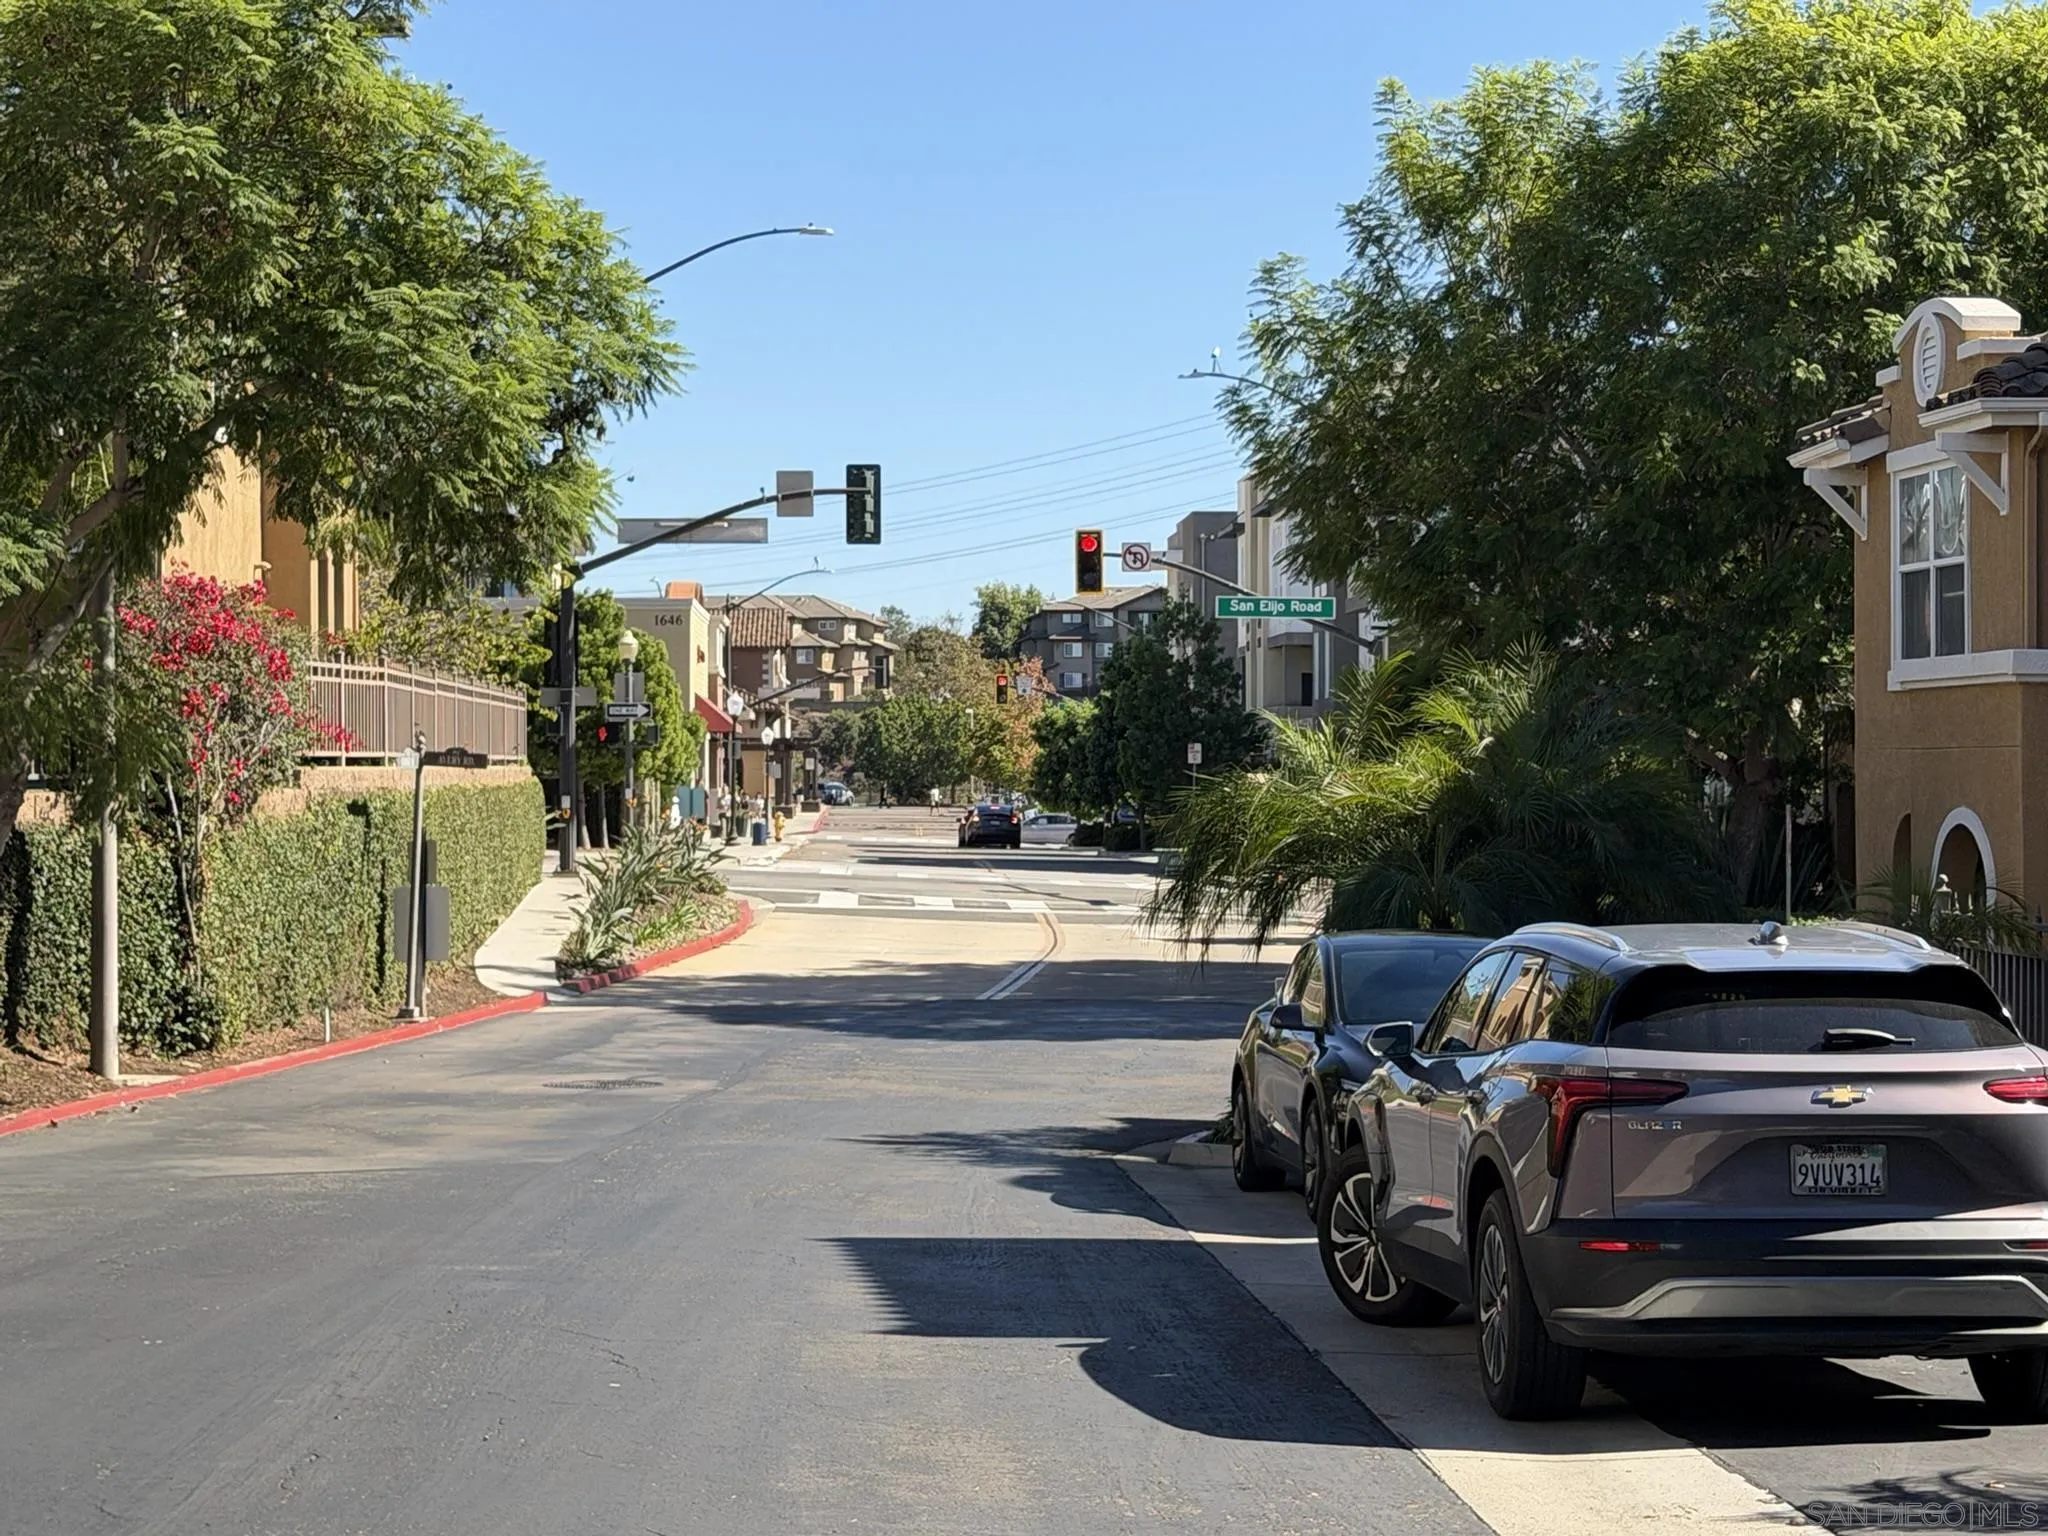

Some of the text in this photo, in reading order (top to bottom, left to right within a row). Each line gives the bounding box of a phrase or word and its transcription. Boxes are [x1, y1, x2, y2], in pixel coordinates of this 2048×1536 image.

[1230, 600, 1322, 615] San Elijo Road
[655, 614, 684, 626] 1646
[1798, 1163, 1882, 1187] 9VUV314
